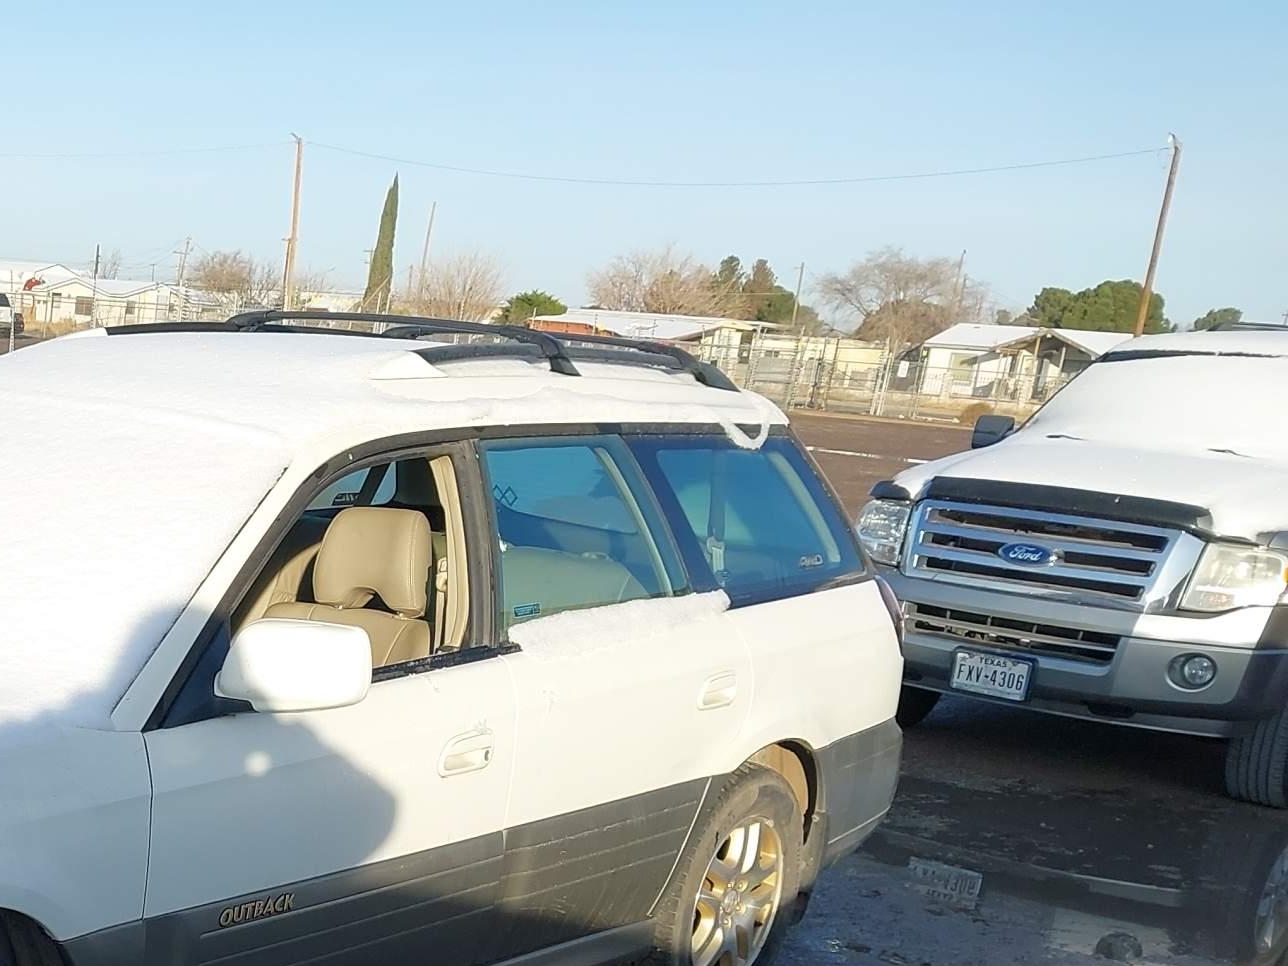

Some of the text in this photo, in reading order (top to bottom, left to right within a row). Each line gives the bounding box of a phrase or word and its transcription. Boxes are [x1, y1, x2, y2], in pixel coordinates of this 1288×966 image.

[1009, 545, 1043, 561] Ford
[979, 656, 1008, 668] TEXAS
[219, 893, 295, 927] OUTBACK
